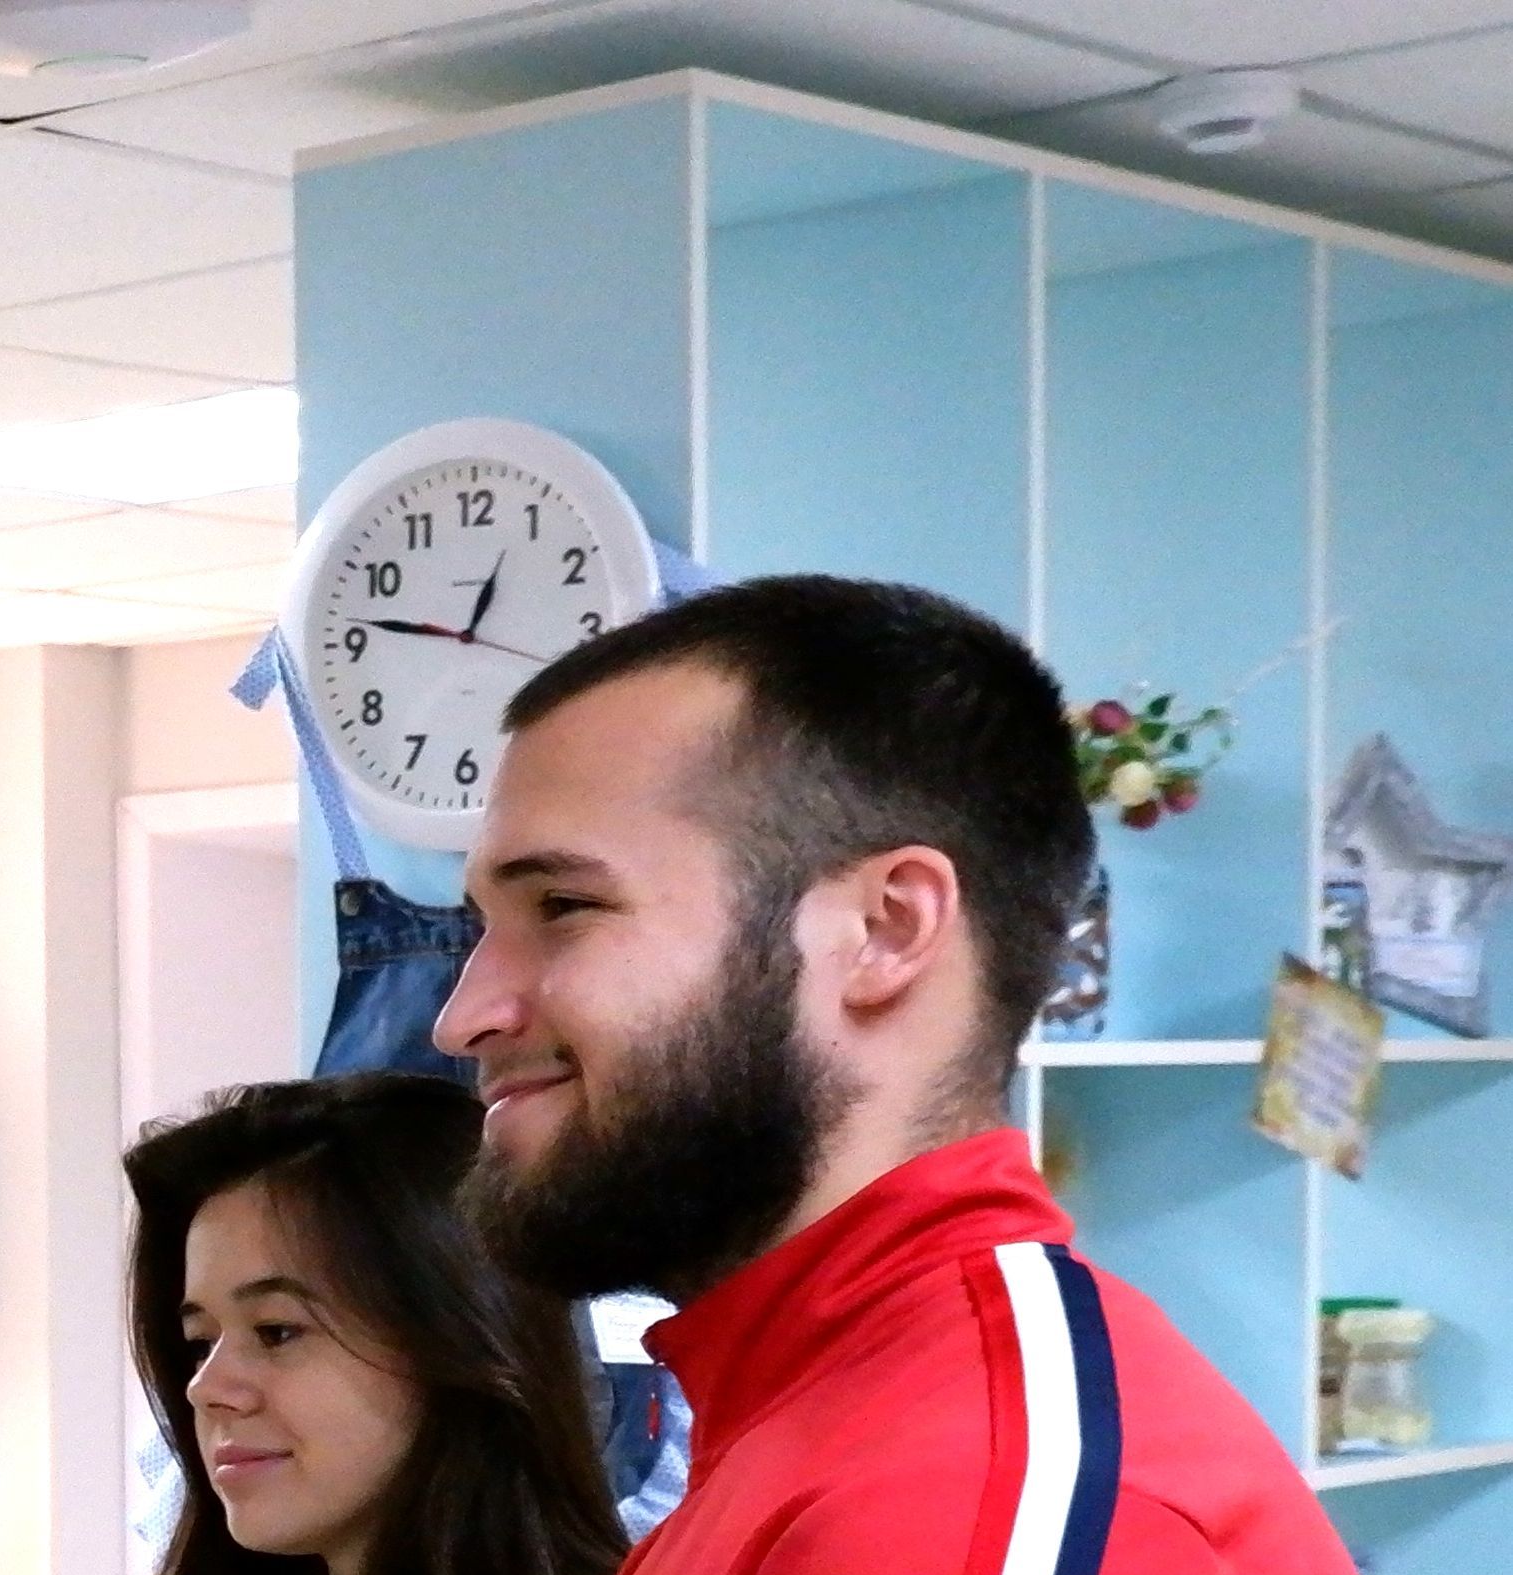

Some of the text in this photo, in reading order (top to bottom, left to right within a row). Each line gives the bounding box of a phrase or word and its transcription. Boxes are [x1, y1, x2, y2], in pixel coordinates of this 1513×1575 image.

[457, 490, 494, 527] 12
[524, 505, 538, 541] 1
[404, 513, 432, 551] 11
[365, 561, 402, 598] 10
[562, 547, 587, 586] 2
[345, 627, 367, 662] 9
[578, 611, 604, 647] 3
[362, 690, 382, 727] 8
[405, 734, 428, 770] 7
[455, 750, 479, 786] 6
